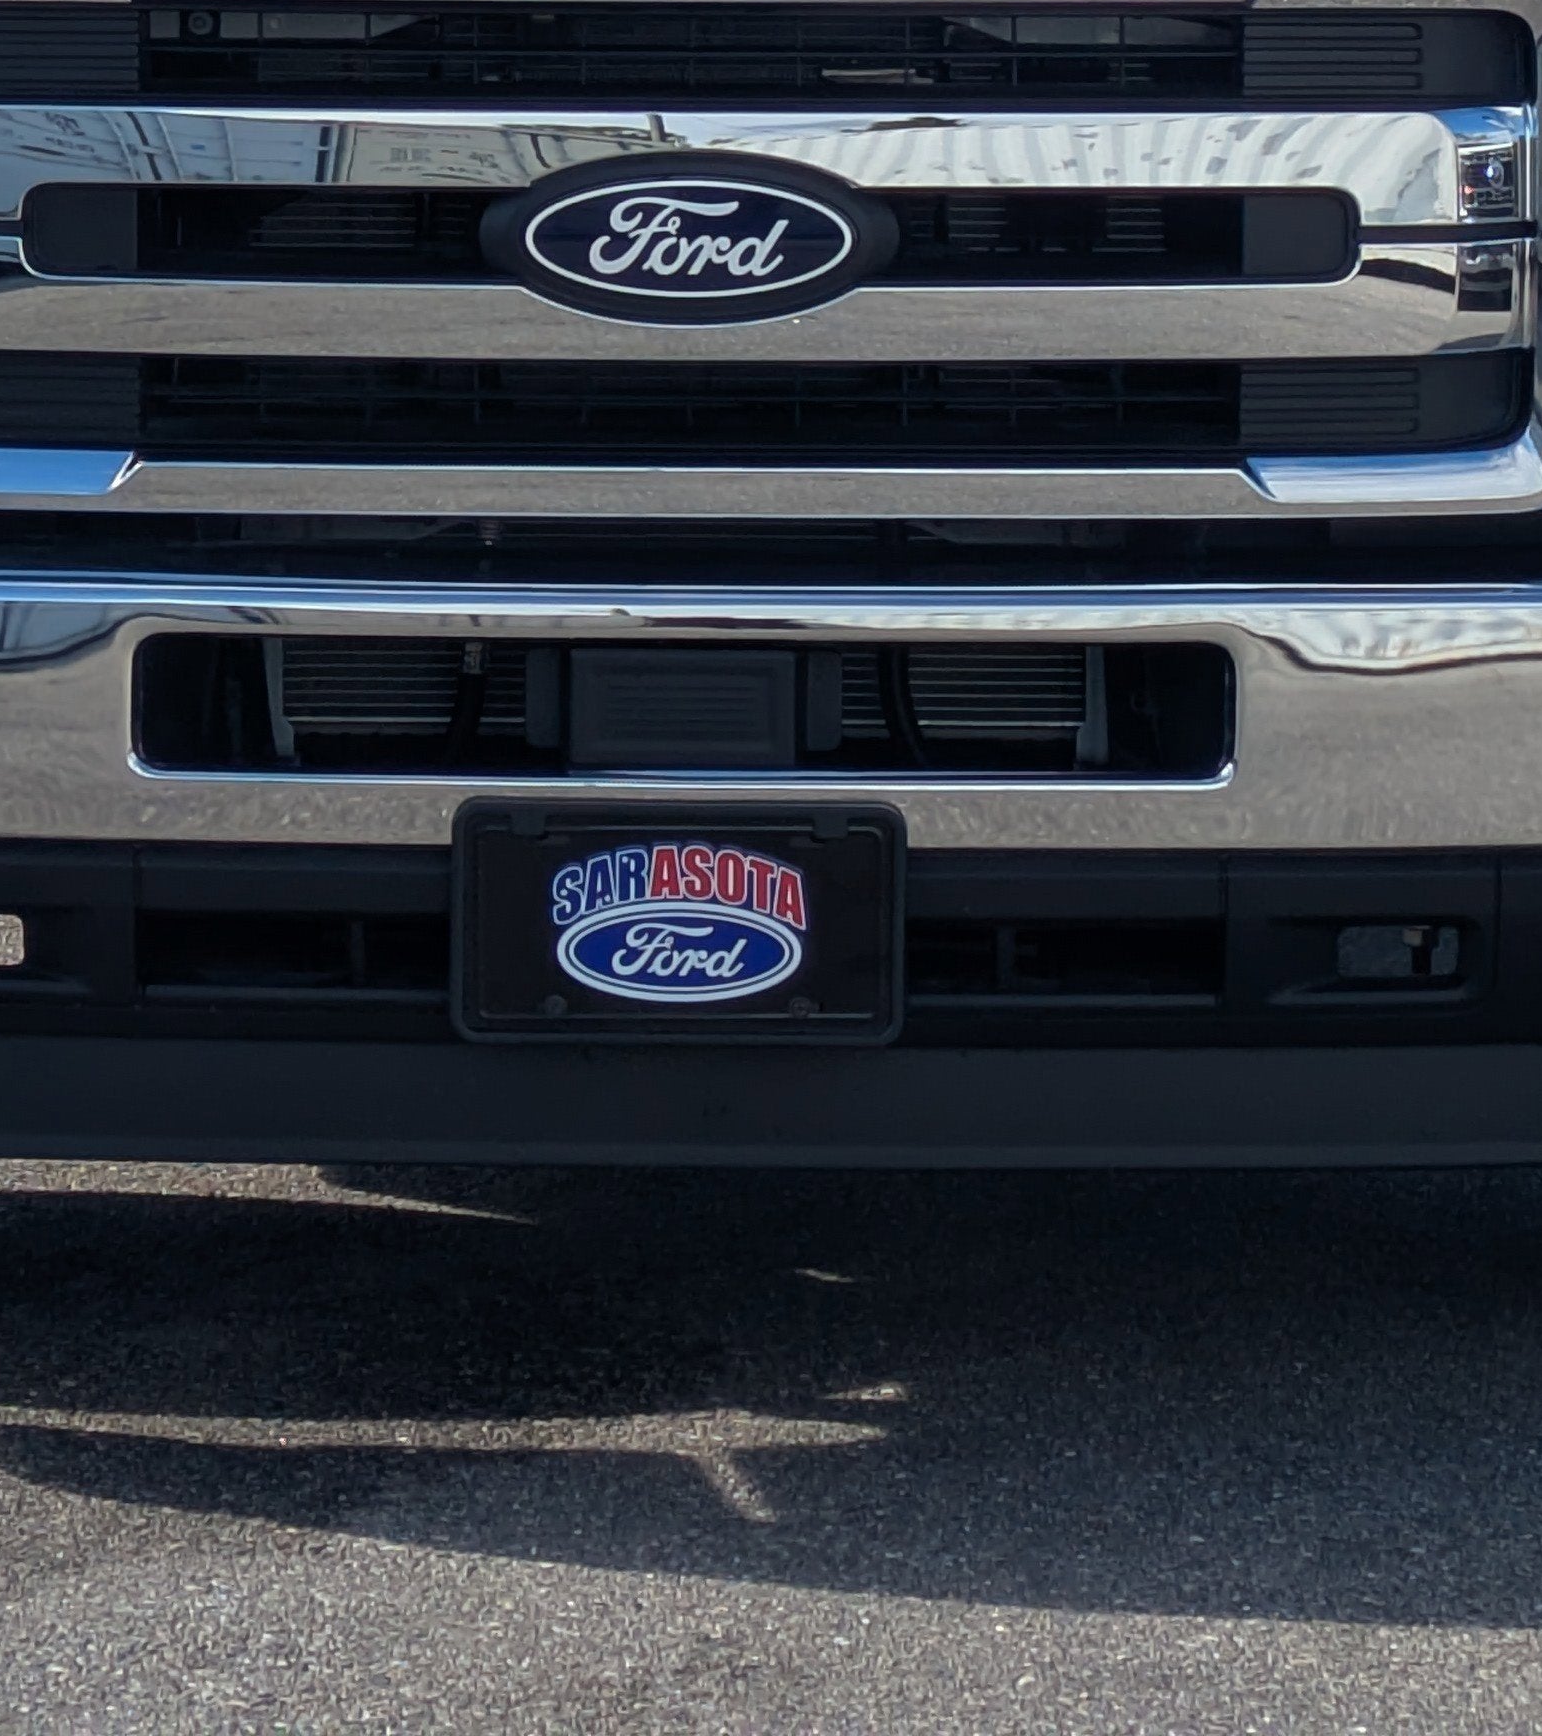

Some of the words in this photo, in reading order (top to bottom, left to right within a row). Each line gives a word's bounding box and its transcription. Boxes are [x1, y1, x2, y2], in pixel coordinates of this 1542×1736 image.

[589, 196, 790, 276] Ford
[552, 842, 809, 931] SARASOTA
[611, 922, 746, 979] Ford
